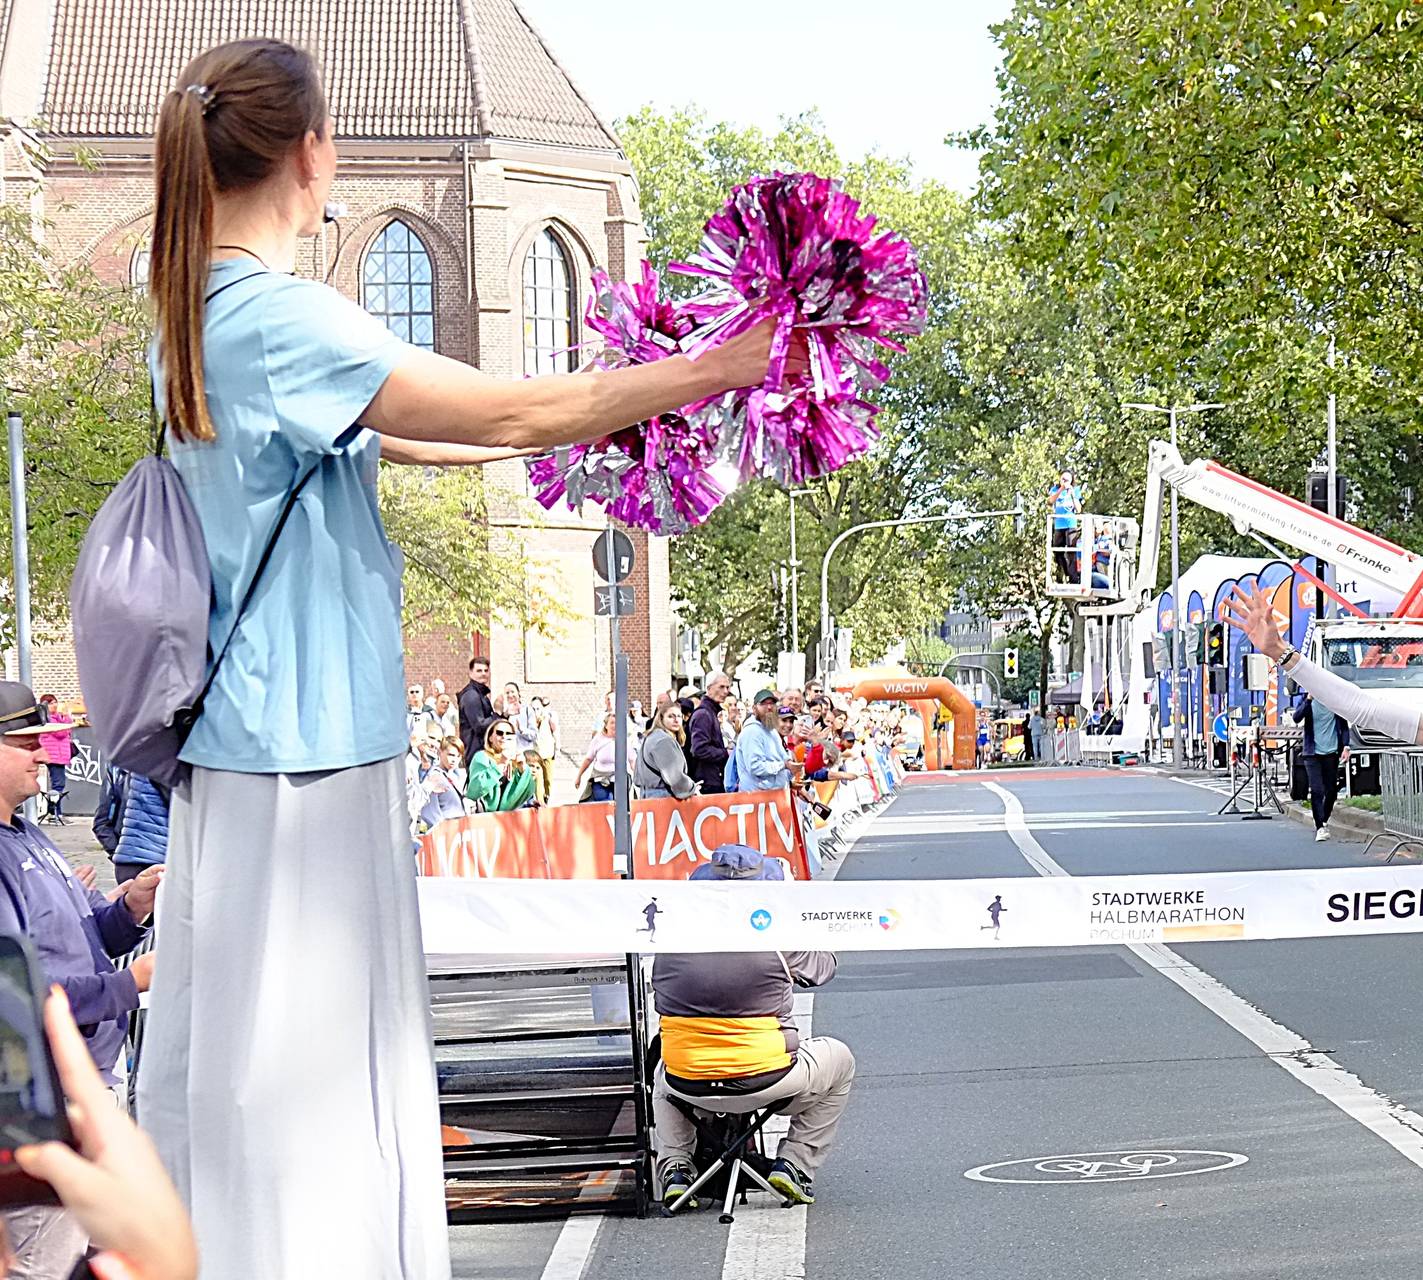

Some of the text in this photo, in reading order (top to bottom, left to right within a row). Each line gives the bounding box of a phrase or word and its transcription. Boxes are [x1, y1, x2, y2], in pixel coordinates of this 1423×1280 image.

[1345, 548, 1392, 574] Franke
[1336, 580, 1358, 593] art
[882, 683, 929, 694] VIACTIV
[606, 801, 795, 866] VIACTIV
[1092, 890, 1205, 906] STADTWERKE
[801, 911, 873, 922] STADTWERKE
[1090, 906, 1245, 924] HALBMARATHON
